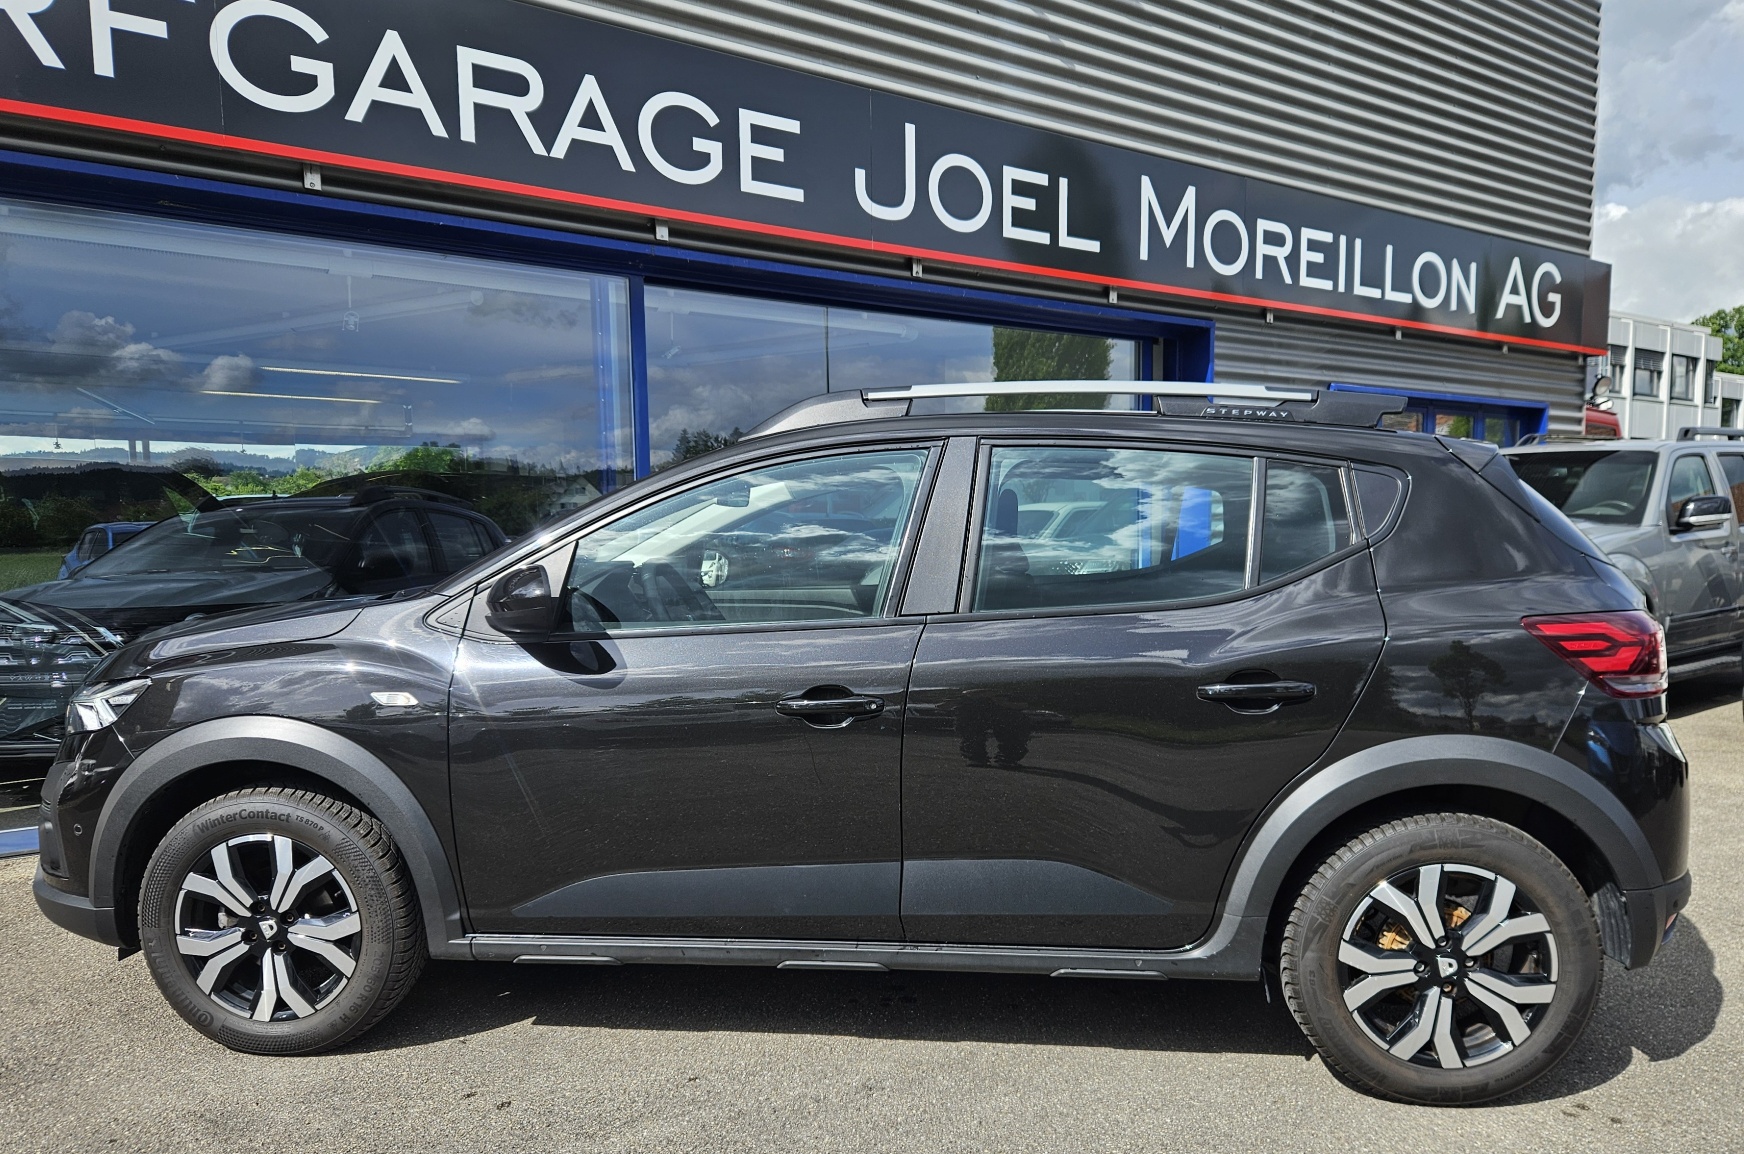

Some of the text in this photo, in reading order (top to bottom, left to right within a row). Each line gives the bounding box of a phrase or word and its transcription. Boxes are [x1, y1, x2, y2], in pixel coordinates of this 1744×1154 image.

[854, 122, 1100, 253] JOEL
[1139, 174, 1477, 315] MOREILLON
[1495, 256, 1562, 328] AG
[1206, 407, 1288, 418] STEPWAY
[197, 808, 292, 834] WinterContact
